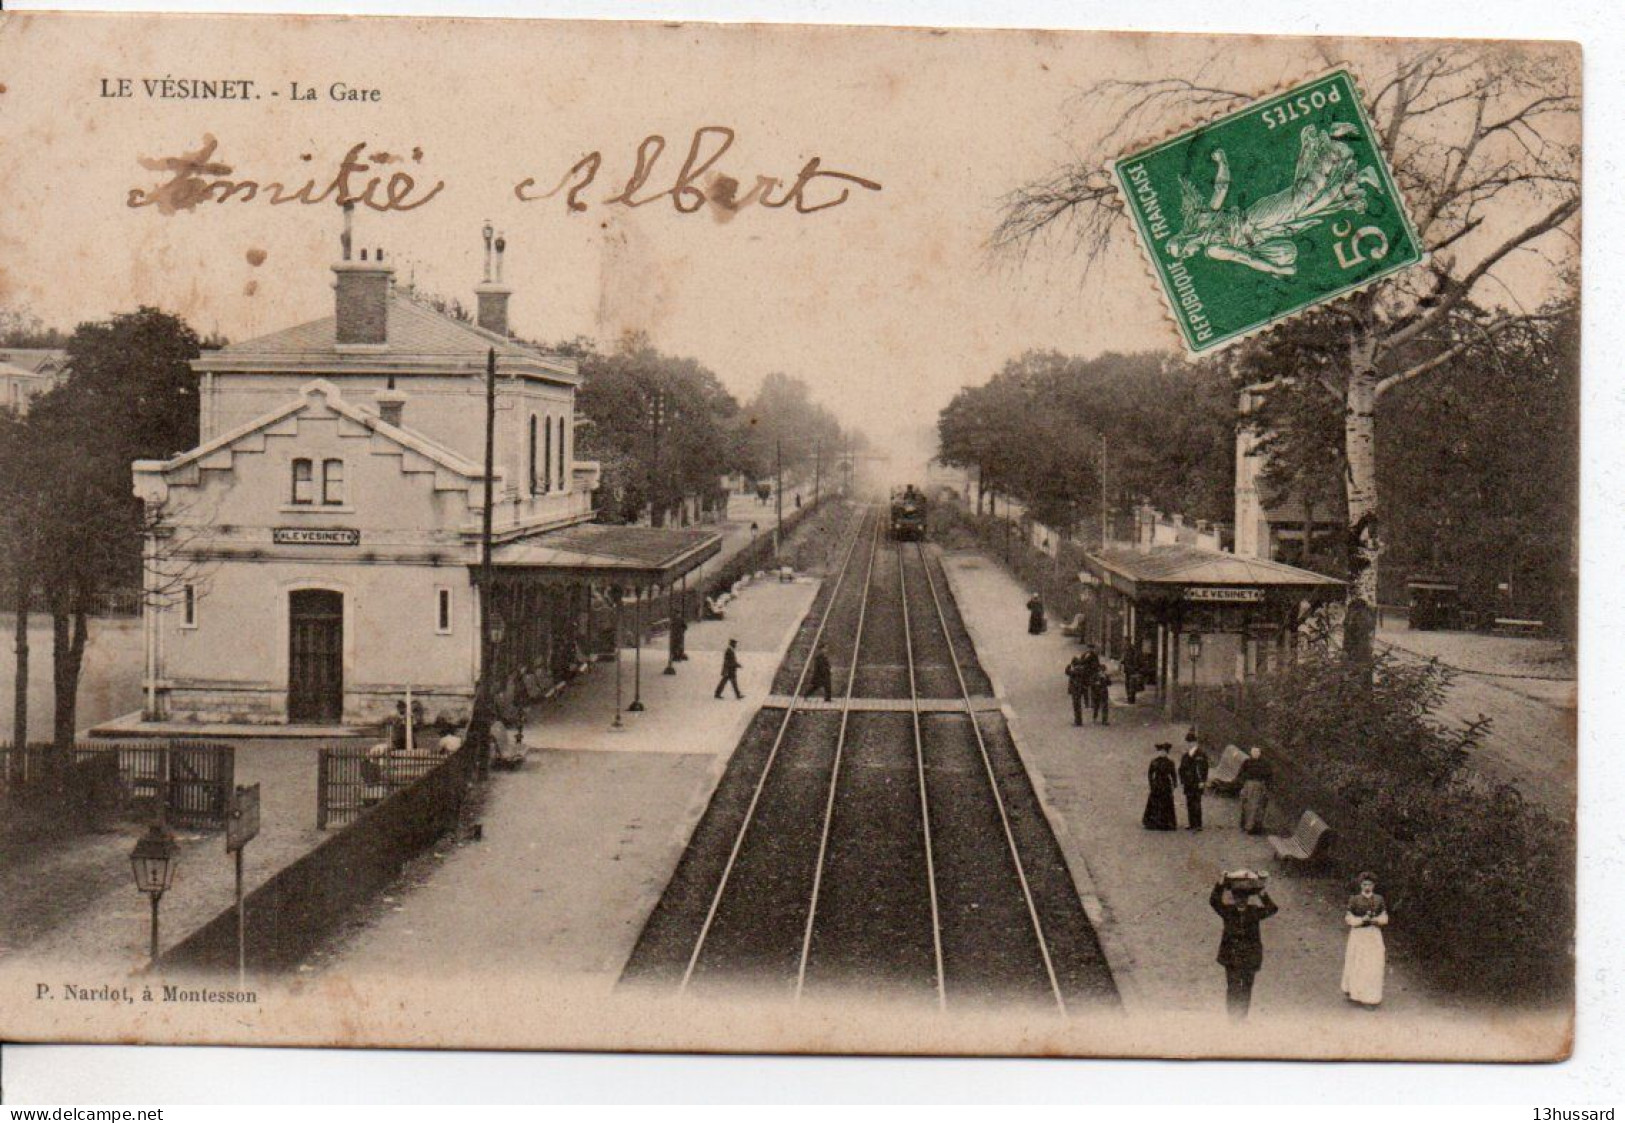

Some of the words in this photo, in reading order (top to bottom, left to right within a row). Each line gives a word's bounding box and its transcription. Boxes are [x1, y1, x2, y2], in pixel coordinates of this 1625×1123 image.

[100, 78, 133, 98] LE
[142, 74, 261, 100] VÉSINET.
[290, 81, 318, 101] La
[329, 82, 381, 102] Gare
[1261, 83, 1342, 130] POSTES
[515, 127, 883, 214] Albert
[1127, 162, 1171, 241] FRANÇAISE
[286, 532, 300, 541] LE
[1194, 590, 1209, 598] LE
[35, 983, 54, 1000] P.
[63, 984, 134, 1004] Nardot,
[142, 985, 154, 1002] à
[163, 985, 257, 1003] Montesson
